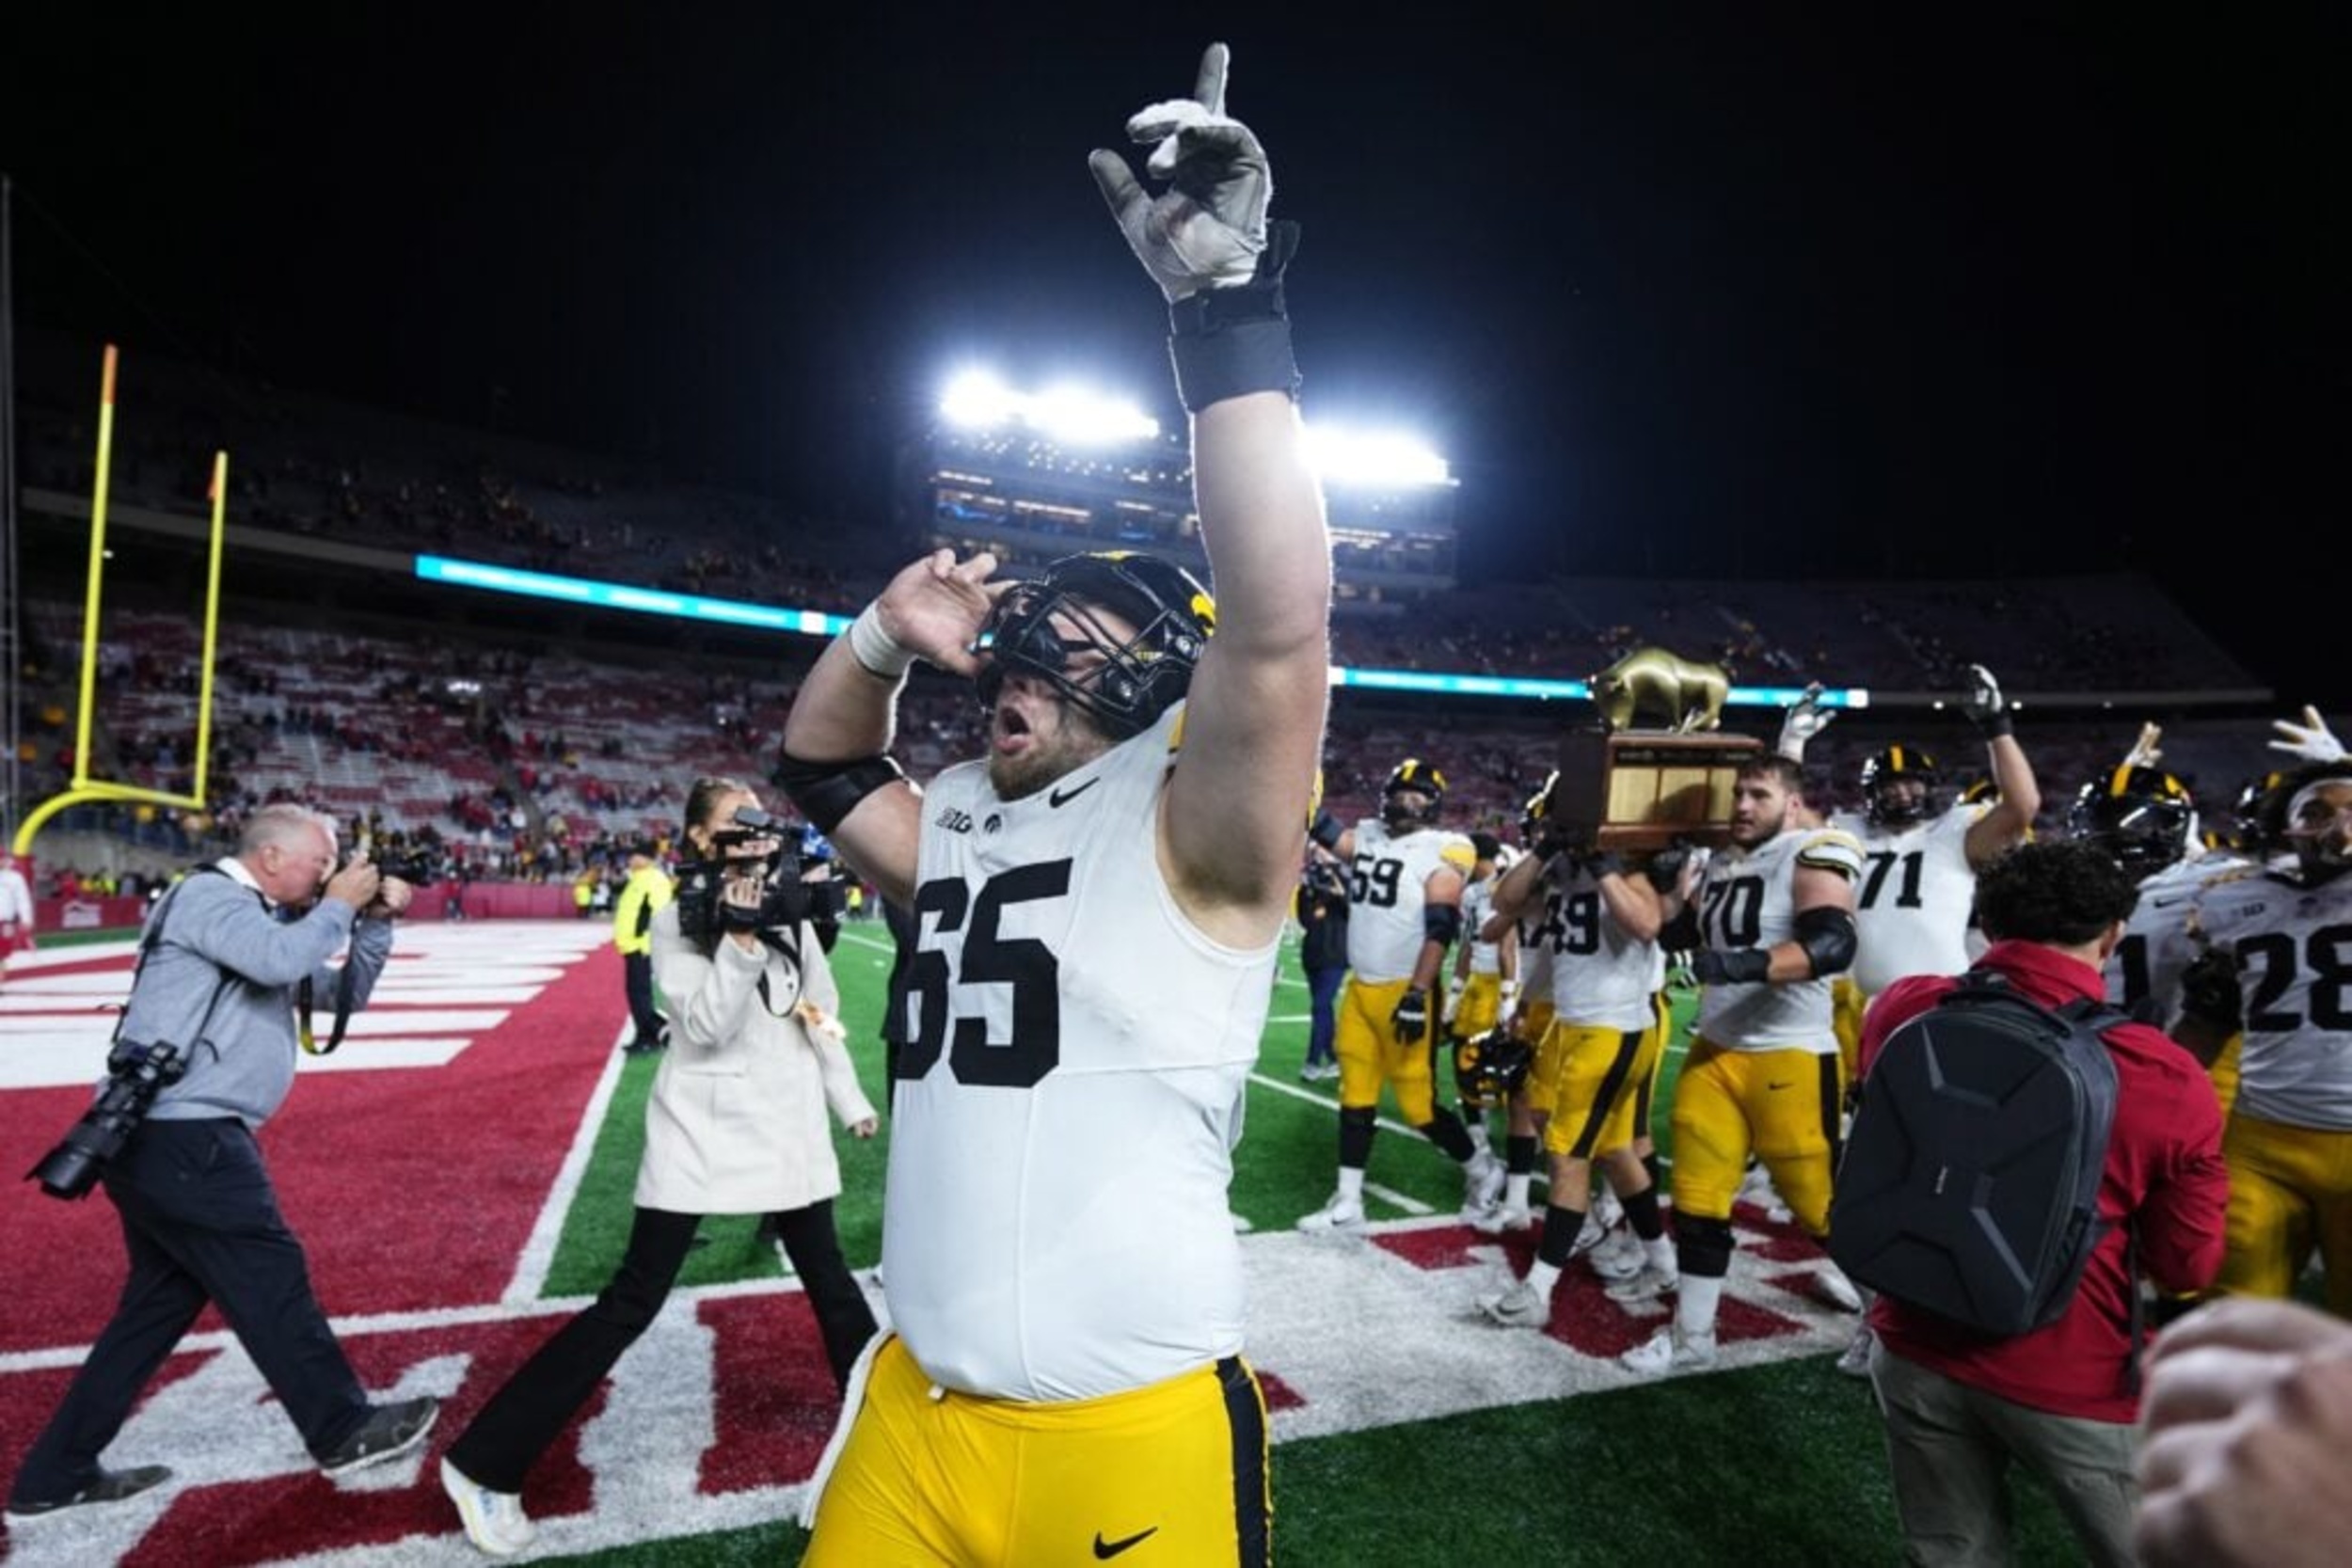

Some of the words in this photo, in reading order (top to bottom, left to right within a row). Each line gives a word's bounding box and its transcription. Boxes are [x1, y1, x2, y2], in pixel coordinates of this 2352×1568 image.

[1350, 852, 1405, 909] 59
[1702, 875, 1765, 947] 70
[1858, 850, 1924, 910] 71
[892, 857, 1073, 1088] 65
[2235, 923, 2352, 1032] 28
